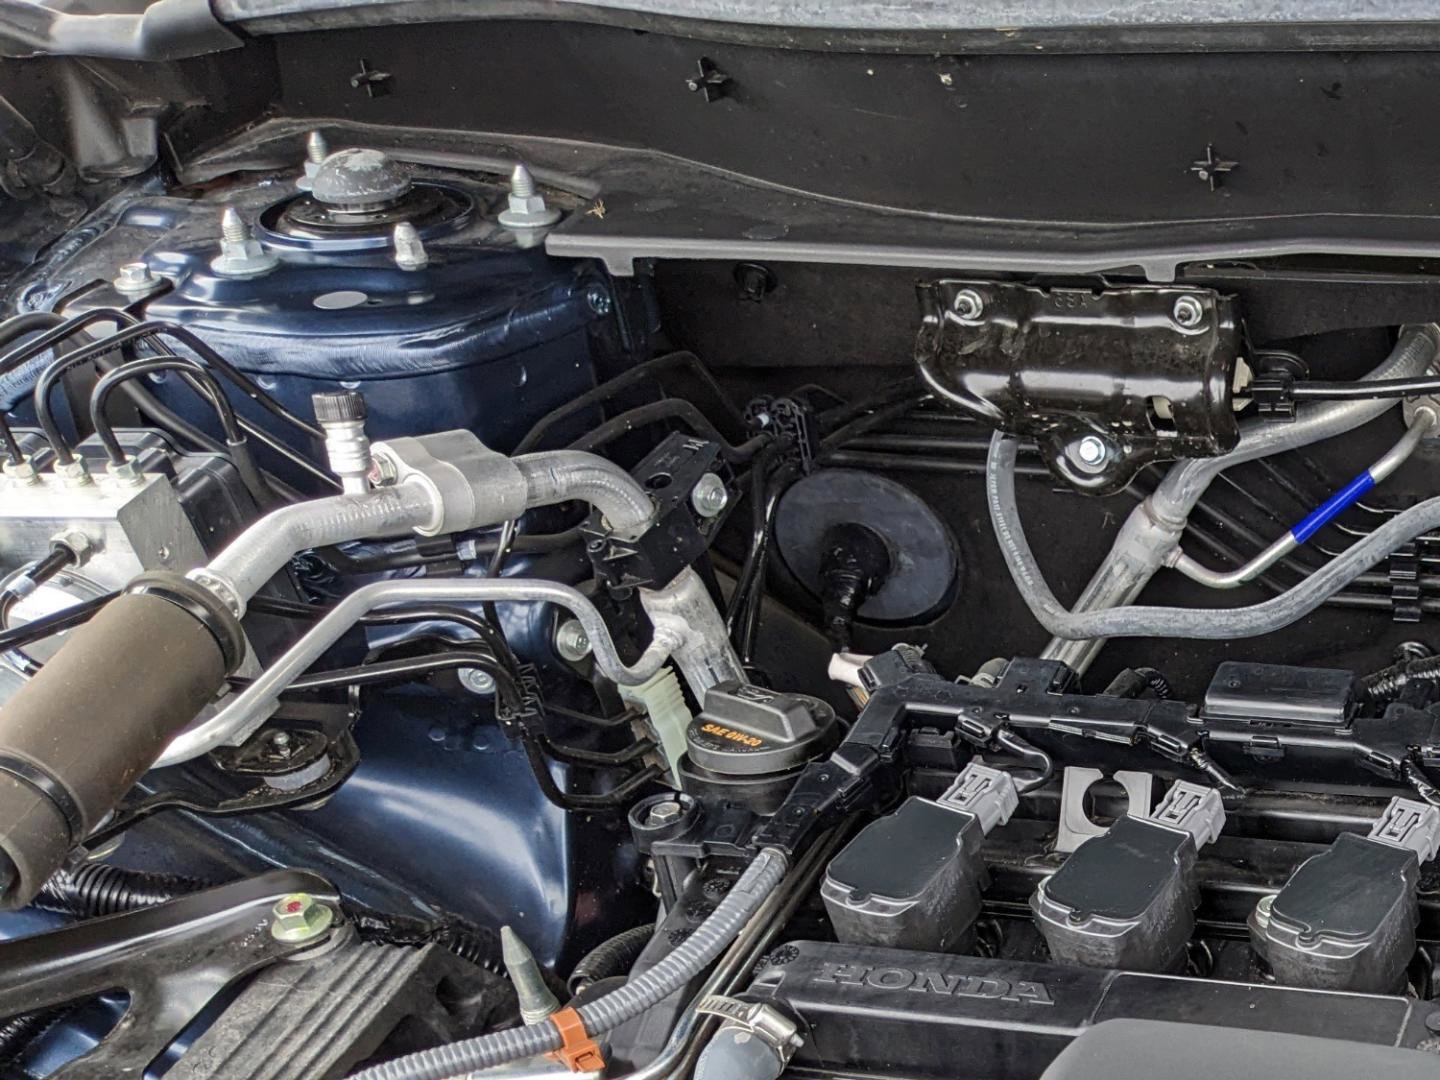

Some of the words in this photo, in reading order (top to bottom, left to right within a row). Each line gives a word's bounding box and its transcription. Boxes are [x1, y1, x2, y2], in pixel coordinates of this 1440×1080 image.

[701, 723, 730, 737] SAE
[726, 728, 763, 747] 0W-20
[813, 961, 1056, 1007] HONDA
